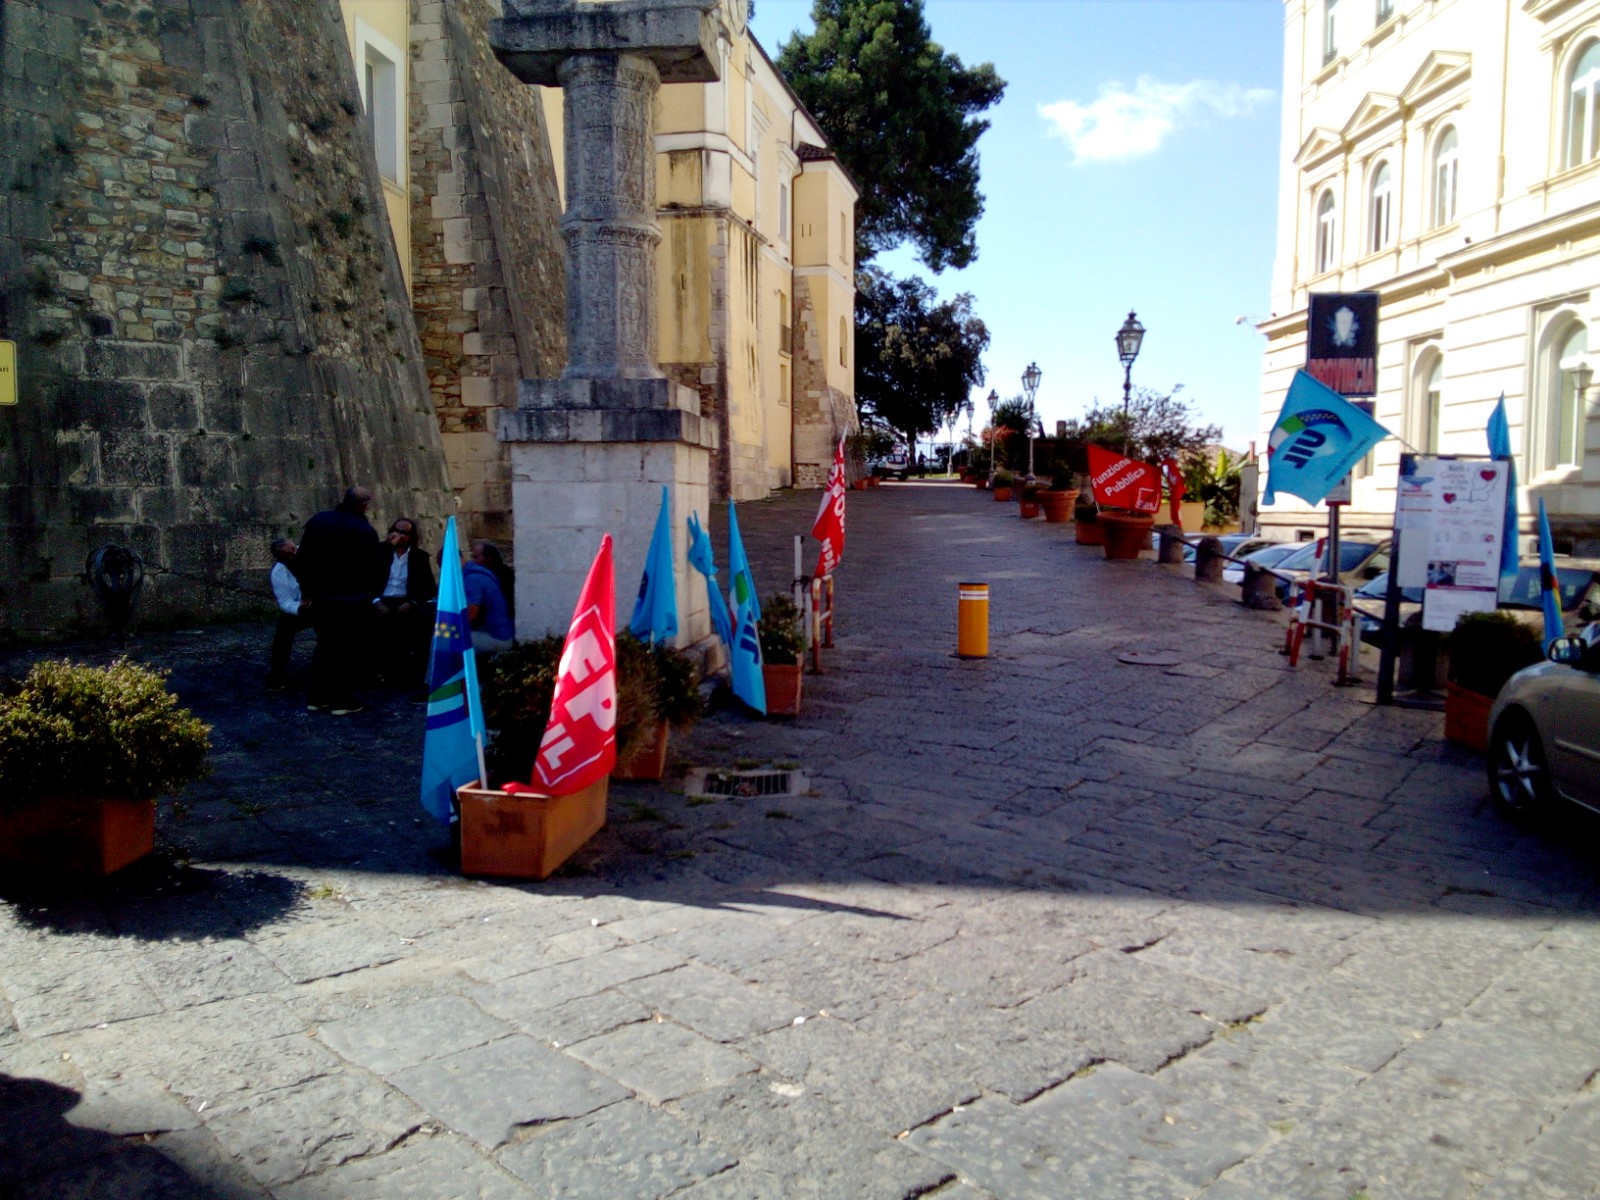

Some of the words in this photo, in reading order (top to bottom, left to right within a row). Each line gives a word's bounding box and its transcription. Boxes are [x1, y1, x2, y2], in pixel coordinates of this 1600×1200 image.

[1091, 457, 1132, 489] Funzione
[1104, 467, 1146, 497] Pubblica
[558, 628, 617, 732] FP
